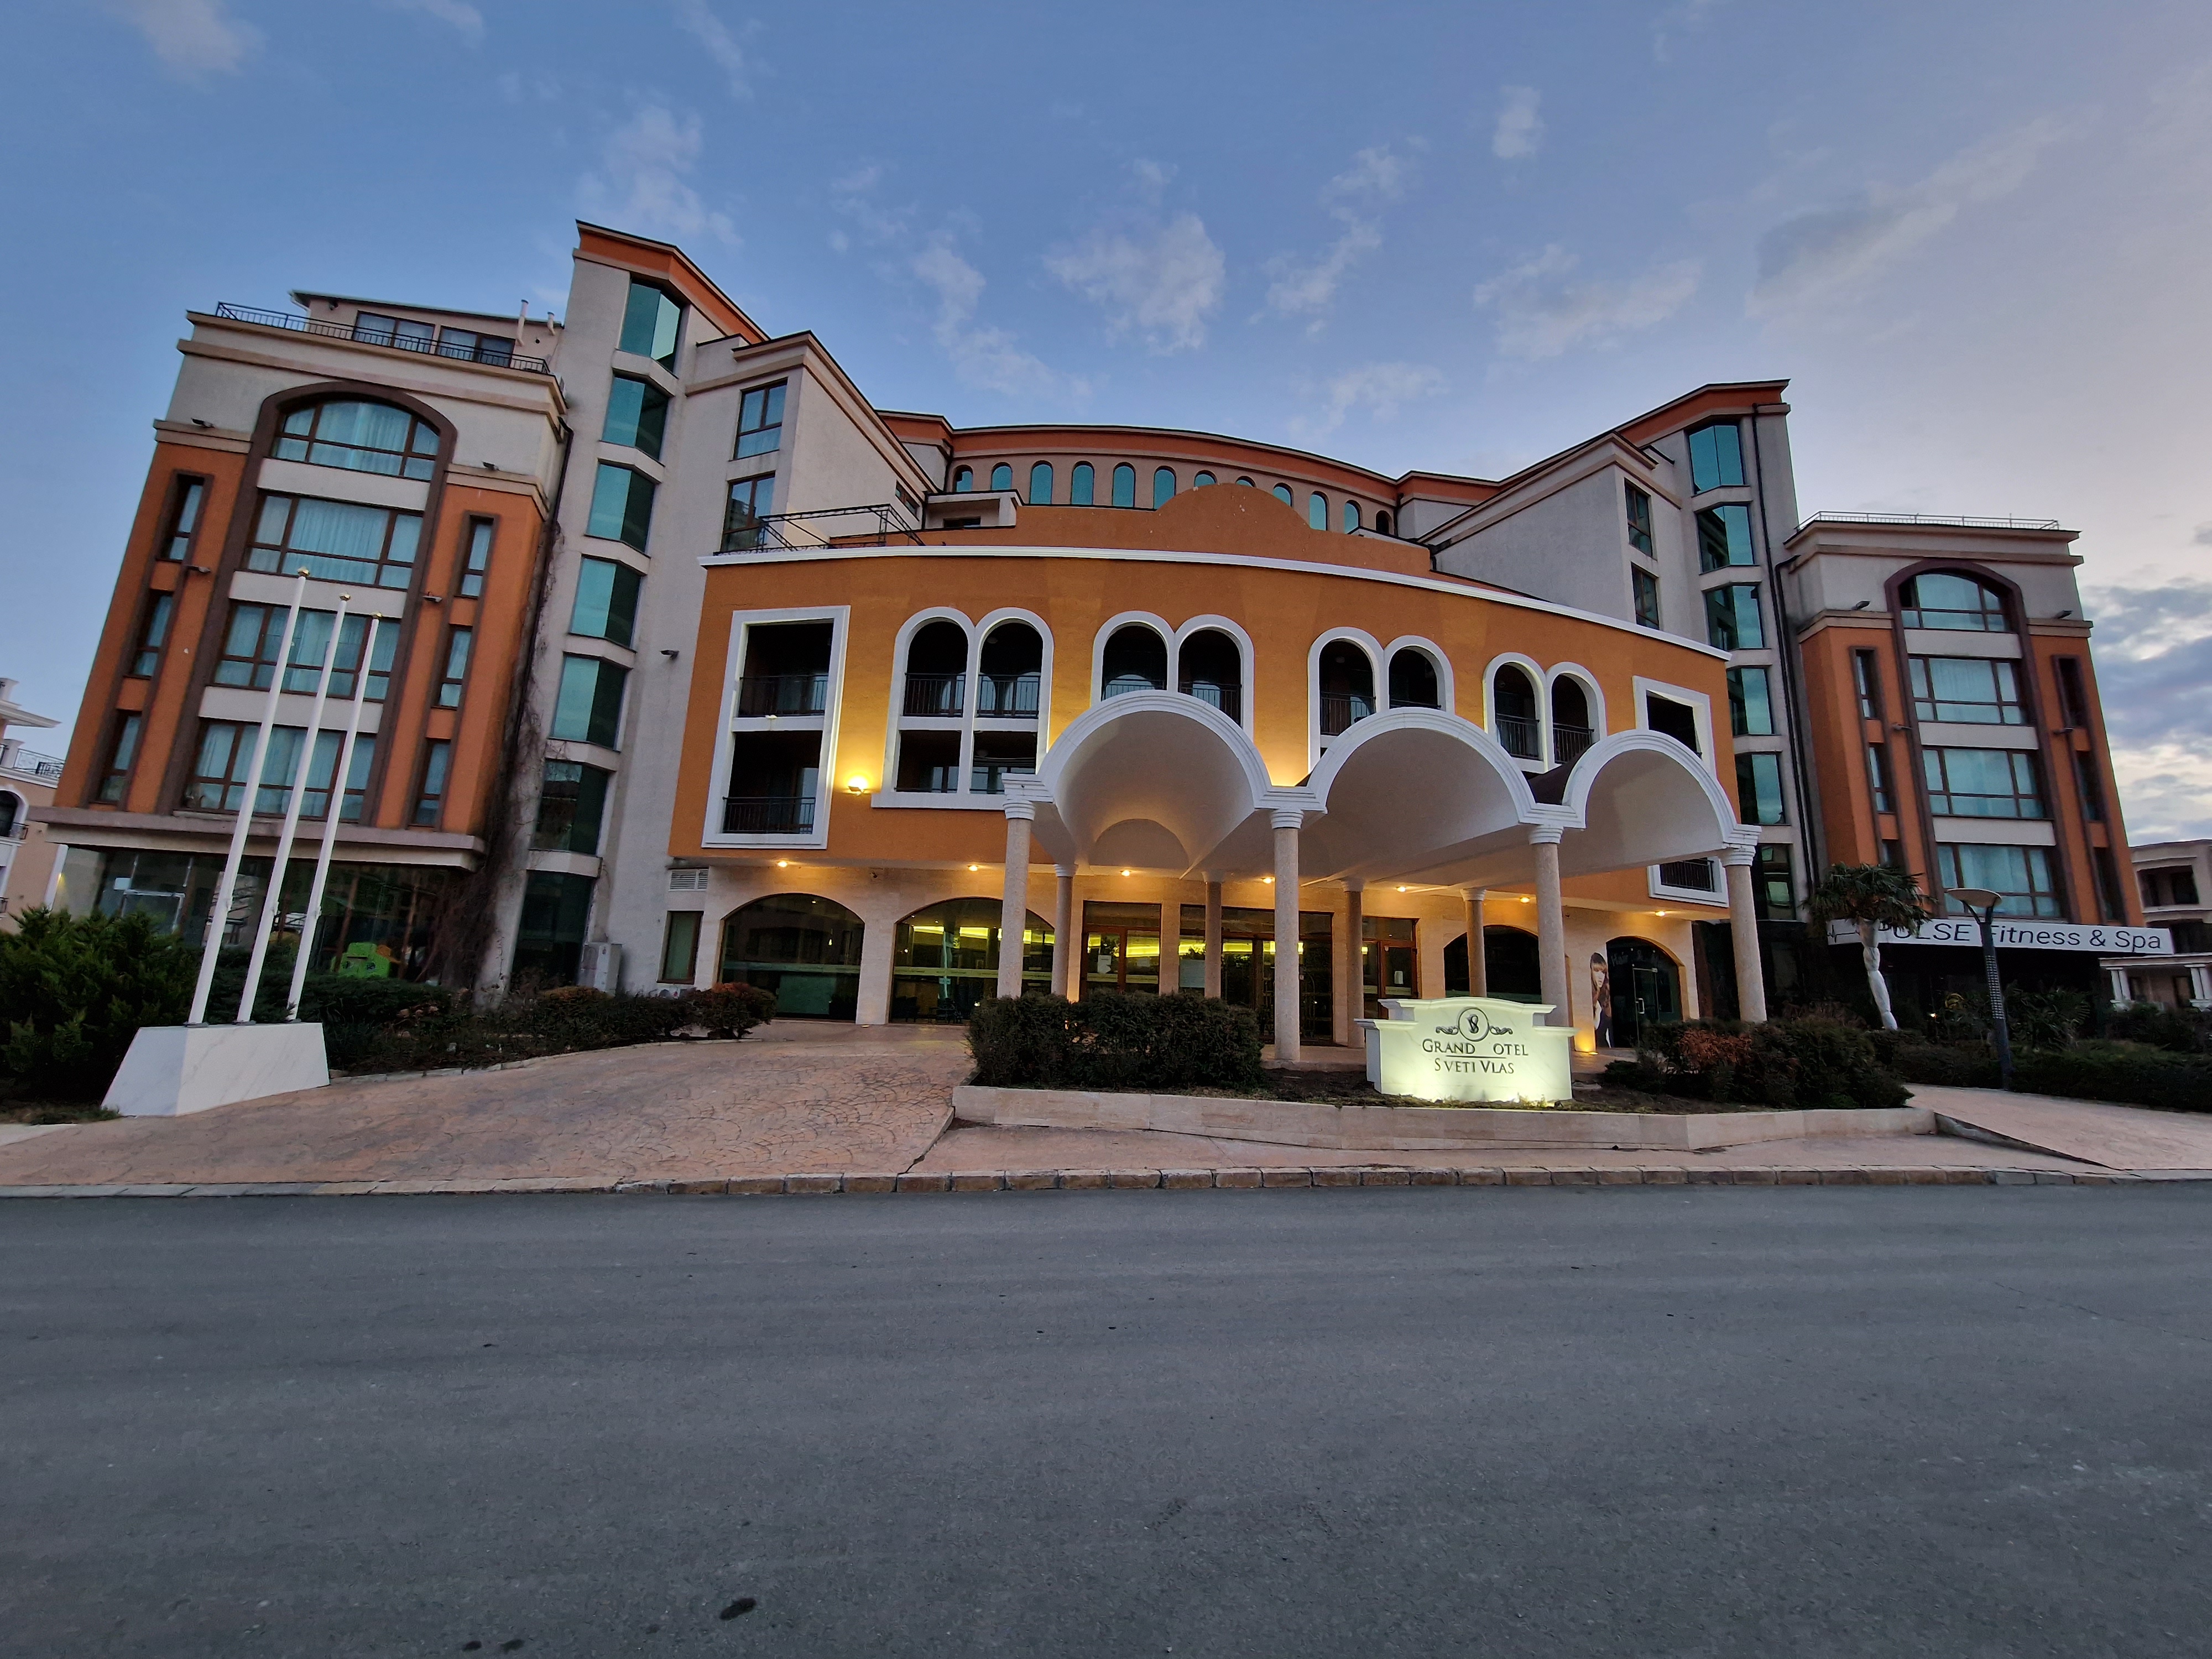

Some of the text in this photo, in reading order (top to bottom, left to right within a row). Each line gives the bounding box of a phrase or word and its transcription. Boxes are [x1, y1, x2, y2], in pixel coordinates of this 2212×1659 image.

[2089, 929, 2106, 947] &
[2115, 931, 2161, 953] Spa
[1422, 1038, 1529, 1056] GRAND OTEL
[1479, 1060, 1515, 1074] VLAS
